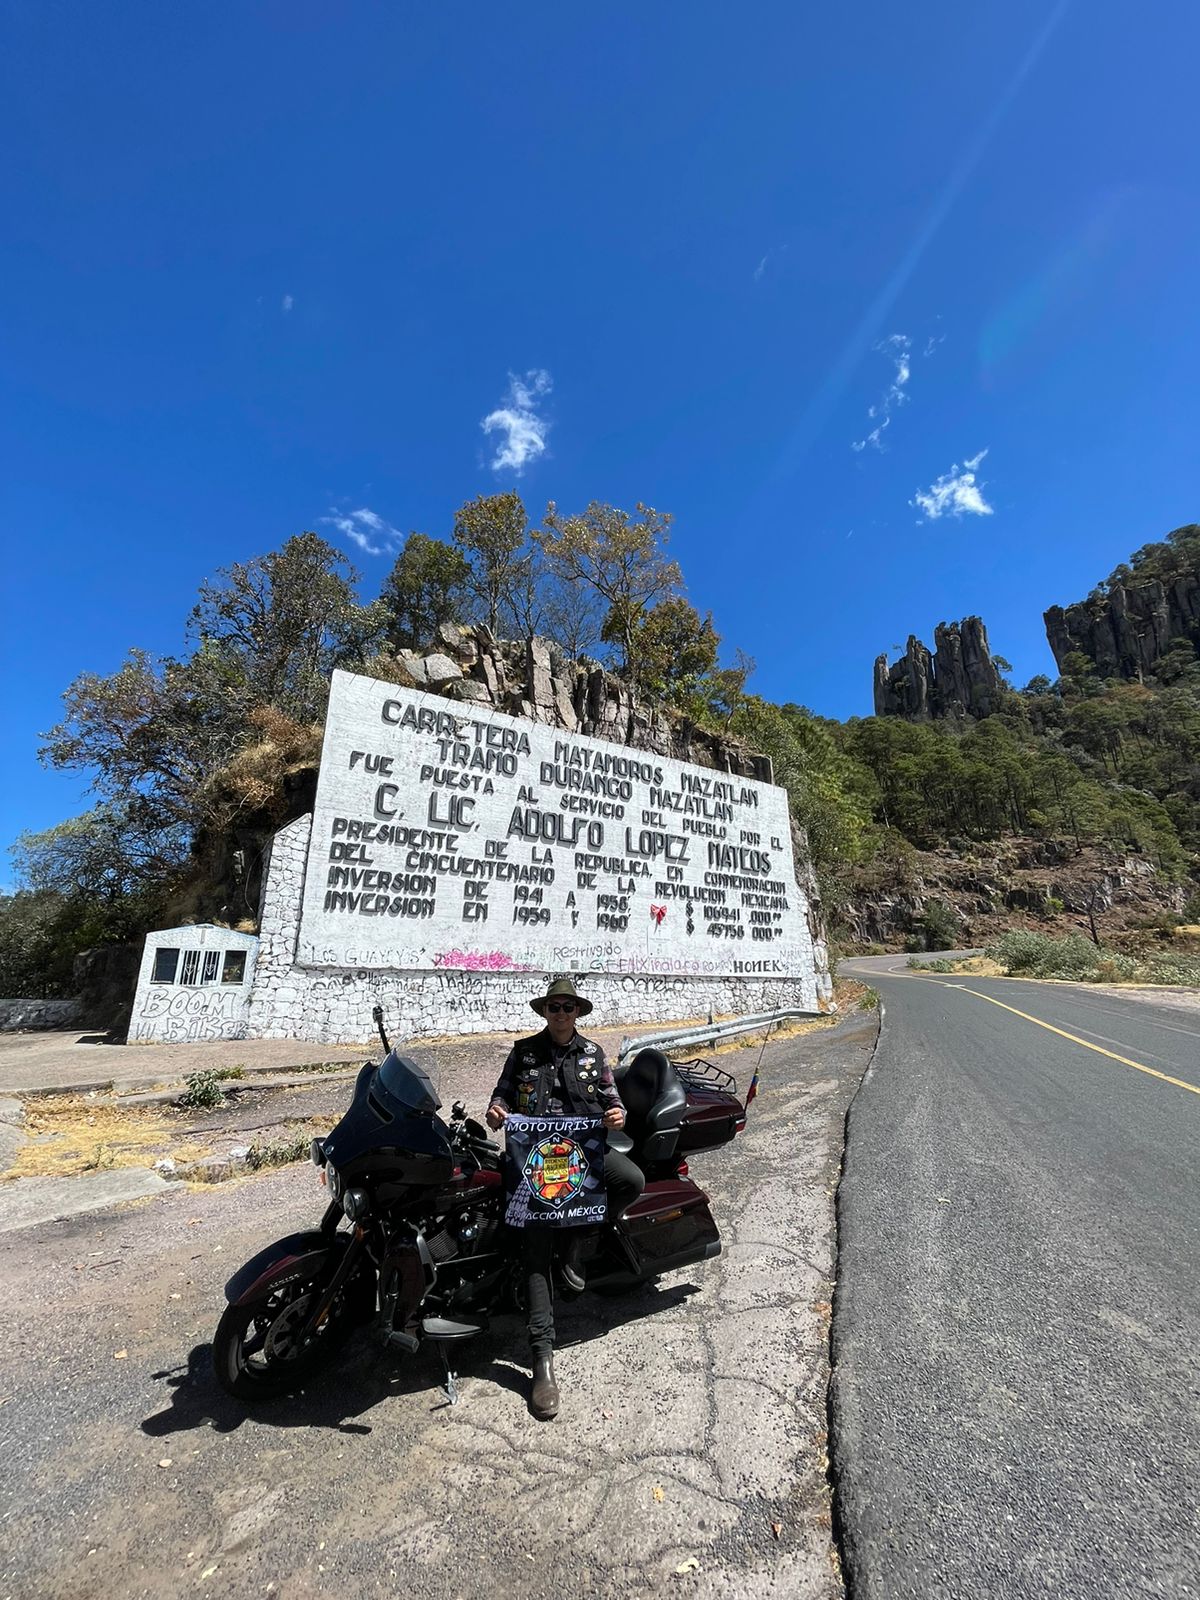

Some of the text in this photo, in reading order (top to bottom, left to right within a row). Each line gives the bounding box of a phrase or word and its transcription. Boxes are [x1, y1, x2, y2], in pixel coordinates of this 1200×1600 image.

[349, 750, 784, 851] FUE PUESTA AL SERVICIO DEL PUEBLO POR EL
[436, 738, 733, 823] TRAMO DURANGO MAZATLAN
[554, 740, 664, 787] MATAMOROS
[680, 772, 759, 809] MAZATLAN
[328, 841, 374, 866] DEL
[405, 850, 555, 886] CINCUENTENARIO
[576, 872, 598, 890] DE
[617, 876, 637, 895] LA
[654, 881, 726, 905] REVOLUCION
[331, 817, 459, 854] PRESIDENTE
[484, 839, 508, 860] DE
[531, 846, 554, 865] LA
[666, 865, 684, 883] EN
[505, 806, 605, 851] ADOLFO
[625, 827, 691, 865] LOPEZ
[707, 841, 772, 877] MATEOS
[322, 890, 436, 919] INVERSION
[462, 901, 489, 924] EN
[512, 906, 551, 927] 1959
[571, 910, 580, 929] Y
[326, 865, 437, 896] INVERSION
[463, 880, 489, 901] DE
[513, 884, 543, 906] 1941
[565, 890, 577, 909] A
[567, 1205, 606, 1218] MÉXICO
